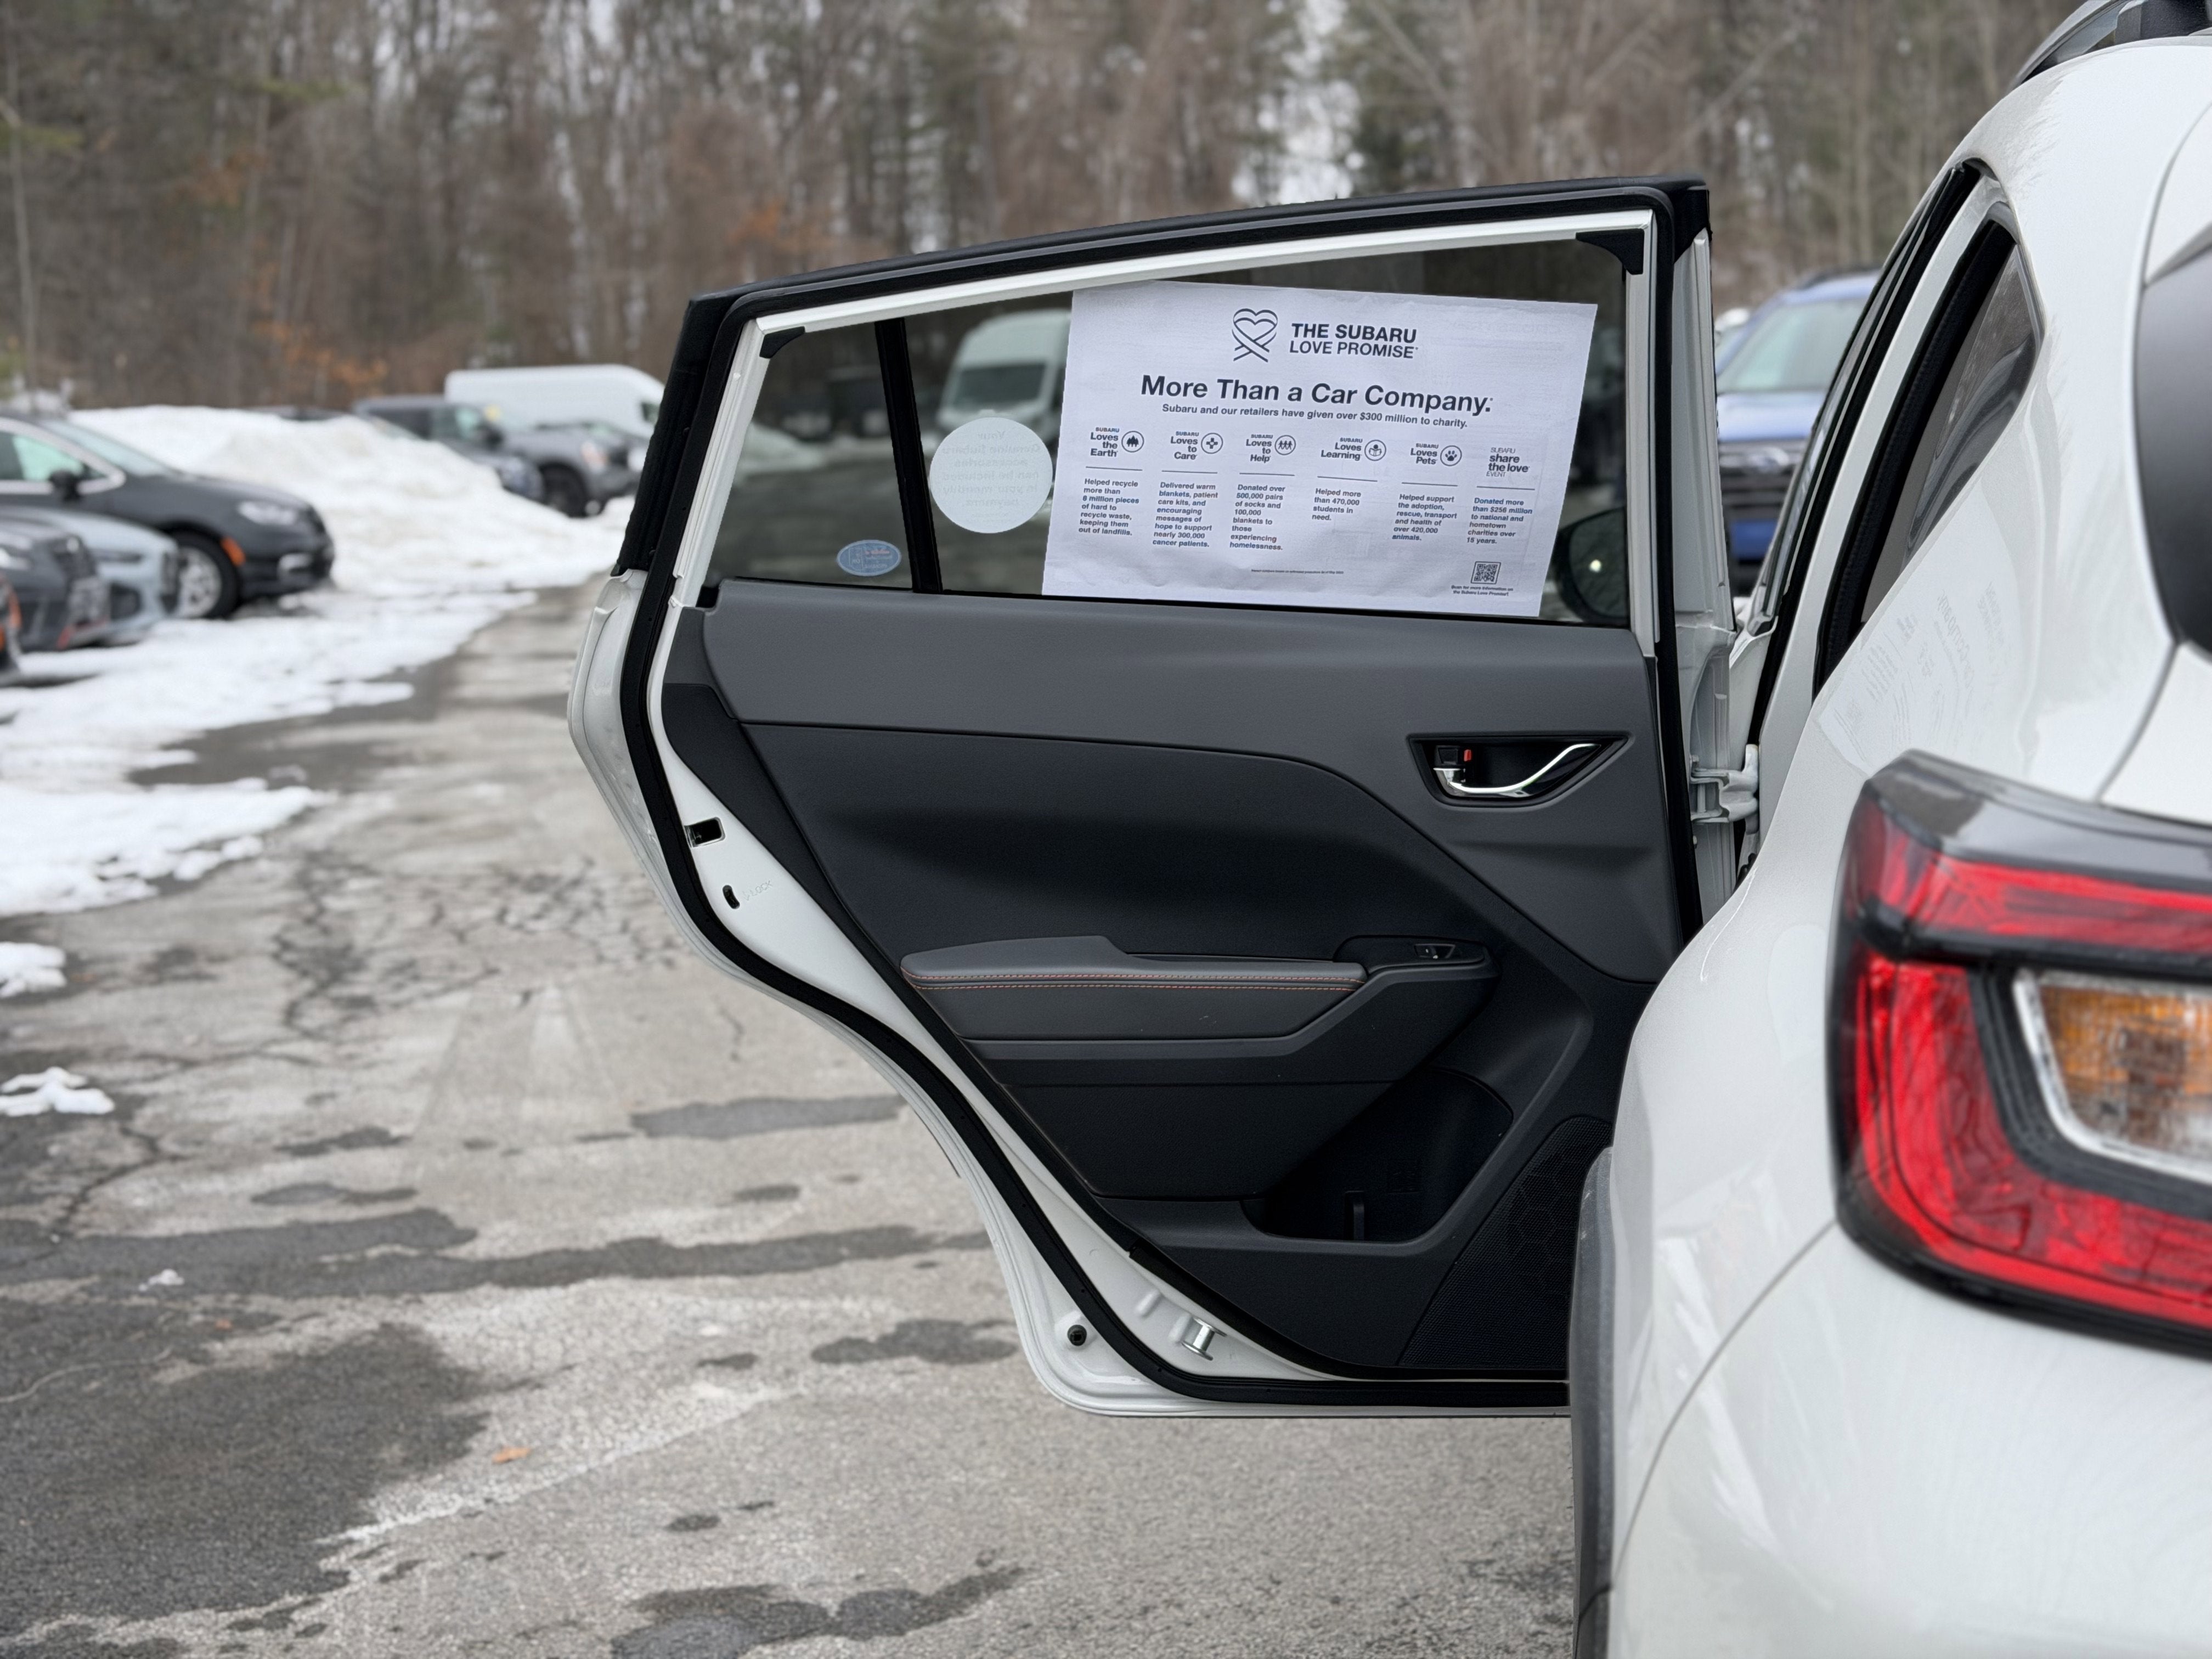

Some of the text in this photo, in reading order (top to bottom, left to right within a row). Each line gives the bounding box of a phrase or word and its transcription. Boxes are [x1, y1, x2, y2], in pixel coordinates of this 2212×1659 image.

[1291, 323, 1417, 343] THE SUBARU
[1289, 340, 1414, 359] LOVE PROMISE
[1141, 374, 1492, 416] More Than a Car Company.
[1162, 403, 1197, 413] Subaru
[1200, 406, 1219, 414] and
[1240, 407, 1279, 416] retailers
[1282, 408, 1305, 417] have
[1307, 409, 1333, 419] given
[1359, 411, 1383, 421] $300
[1385, 414, 1418, 424] million
[1433, 417, 1468, 430] charity.
[1090, 432, 1119, 441] Loves
[1170, 436, 1198, 445] Loves
[1102, 441, 1118, 449] the
[1246, 439, 1272, 448] Loves
[1335, 442, 1362, 451] Loves
[1091, 448, 1117, 458] Earth
[1174, 451, 1197, 460] Care
[1321, 450, 1361, 461] Learning
[1410, 448, 1437, 456] Loves
[1250, 454, 1270, 464] Help
[1415, 456, 1436, 465] Pets
[1489, 454, 1520, 463] share
[1488, 462, 1528, 472] the love
[1159, 490, 1192, 499] blankets,
[1400, 494, 1425, 502] Helped
[1411, 503, 1444, 511] adoption,
[1424, 511, 1457, 520] transport
[1080, 519, 1108, 528] keeping
[1468, 528, 1498, 537] charities
[1231, 534, 1277, 543] experiencing
[1229, 541, 1283, 550] homelessness.
